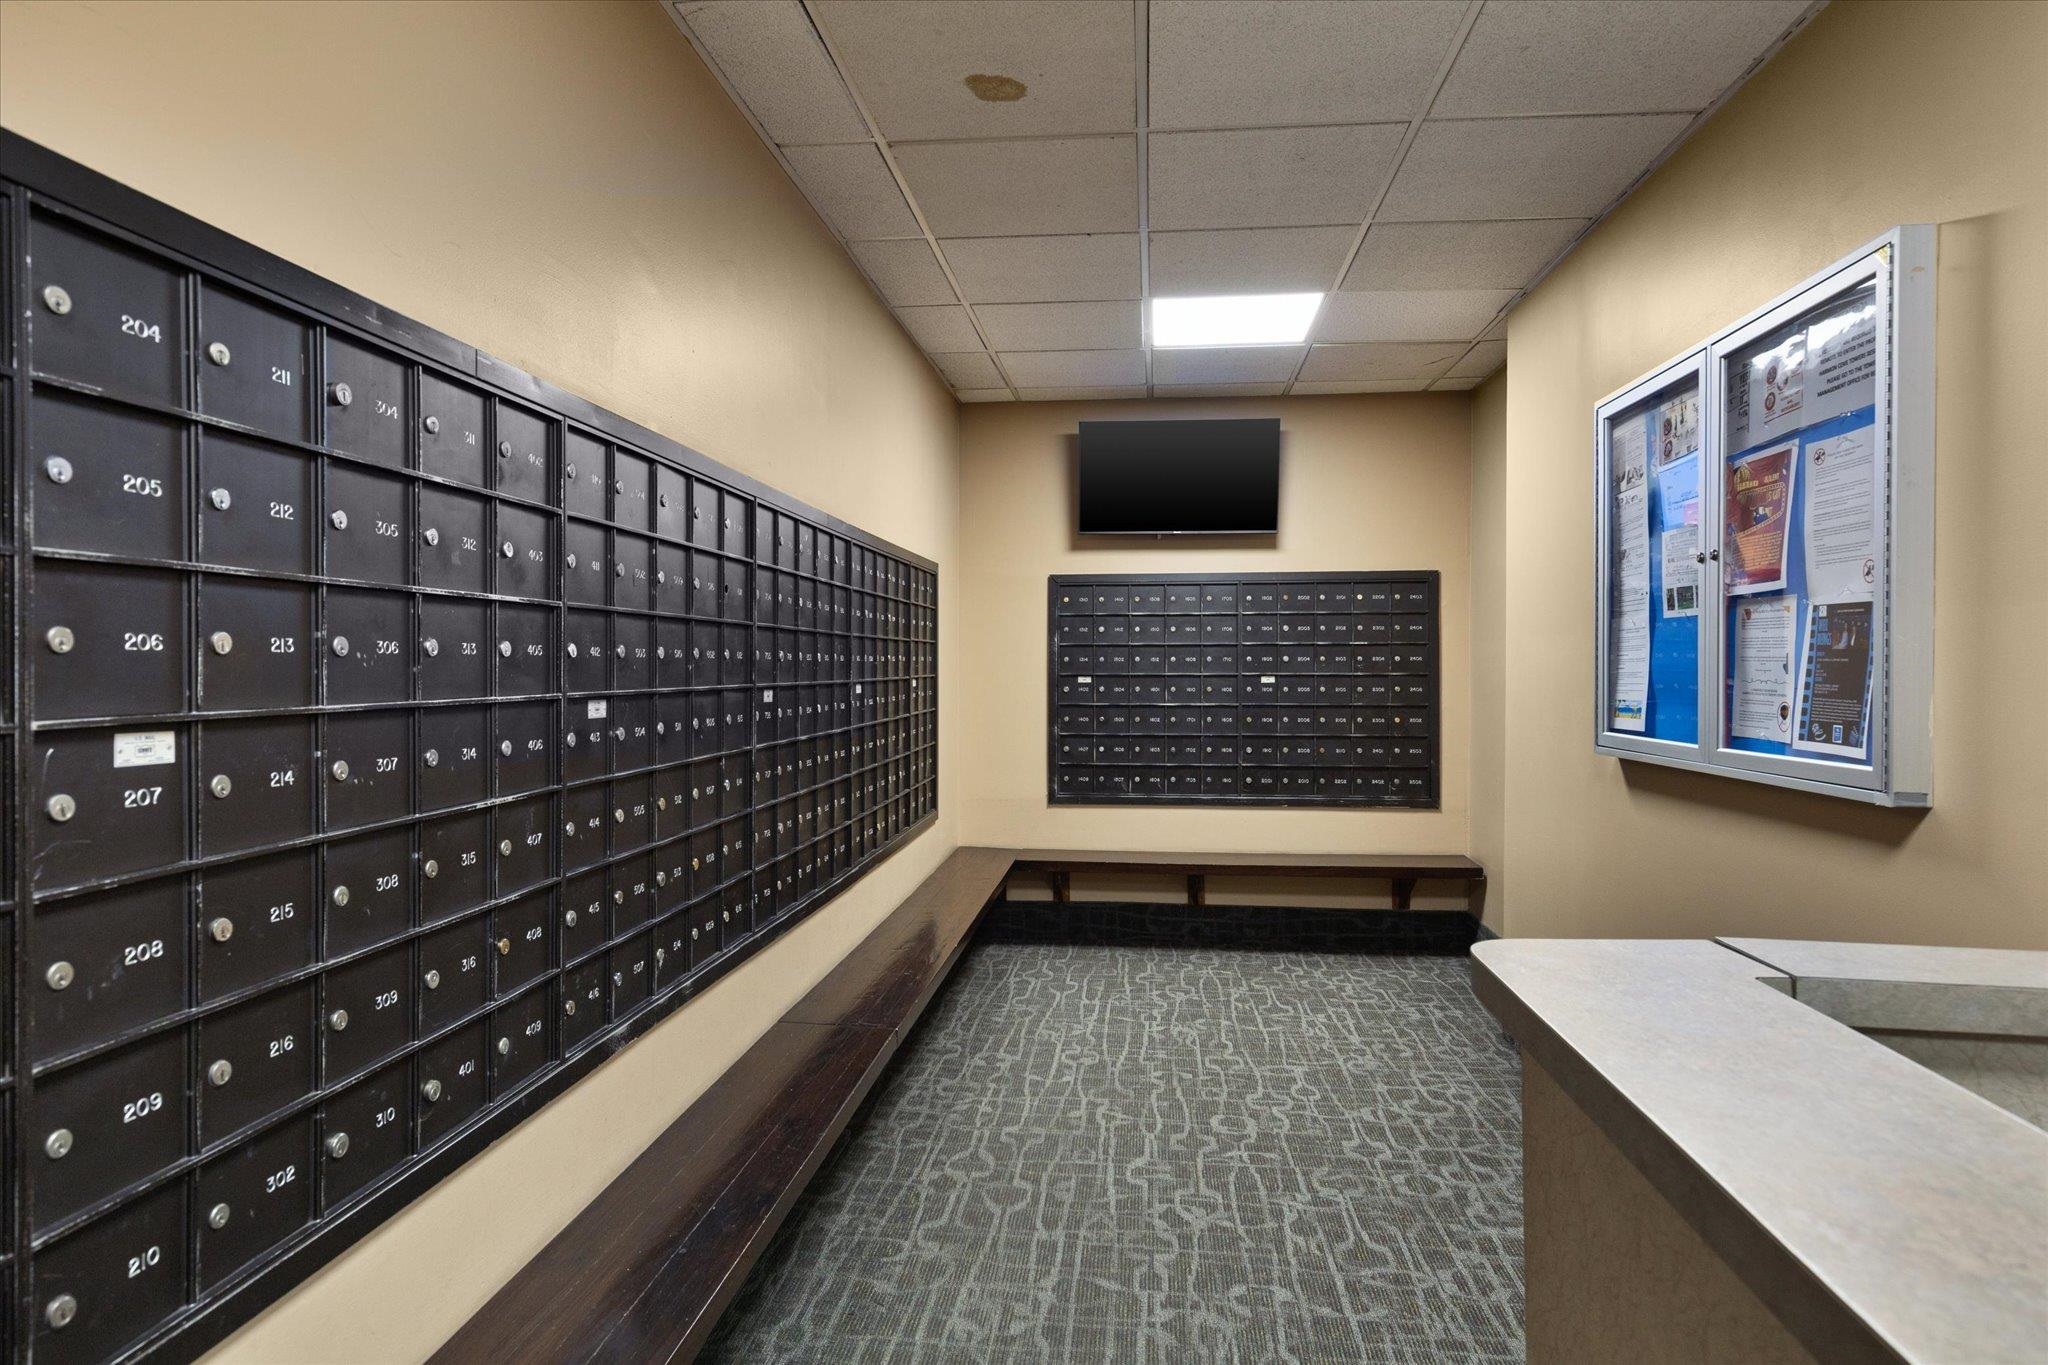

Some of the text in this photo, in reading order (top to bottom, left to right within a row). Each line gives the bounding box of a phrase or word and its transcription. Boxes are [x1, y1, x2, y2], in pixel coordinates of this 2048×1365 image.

[121, 315, 162, 343] 204
[272, 366, 291, 386] 211
[375, 401, 398, 420] 304
[464, 431, 475, 445] 311
[123, 474, 163, 497] 205
[270, 502, 294, 520] 212
[375, 520, 399, 537] 305
[461, 536, 477, 551] 312
[528, 549, 543, 562] 403
[591, 561, 600, 571] 411
[124, 632, 164, 651] 206
[271, 637, 295, 653] 213
[376, 640, 399, 654] 306
[461, 642, 477, 655] 313
[590, 646, 601, 657] 412
[527, 739, 543, 751] 406
[589, 732, 601, 742] 413
[461, 747, 477, 761] 314
[376, 757, 398, 772] 307
[270, 770, 295, 787] 214
[124, 786, 162, 808] 207
[589, 817, 600, 828] 414
[527, 832, 542, 846] 407
[461, 851, 476, 866] 315
[376, 874, 399, 892] 308
[270, 902, 294, 923] 215
[588, 901, 600, 914] 415
[526, 926, 542, 941] 408
[125, 940, 164, 966] 208
[461, 955, 476, 972] 316
[375, 990, 398, 1010] 309
[588, 987, 600, 1000] 416
[525, 1020, 542, 1036] 409
[270, 1035, 294, 1058] 216
[458, 1059, 474, 1076] 401
[123, 1092, 162, 1123] 209
[376, 1107, 395, 1128] 310
[266, 1165, 295, 1193] 302
[128, 1246, 160, 1278] 210
